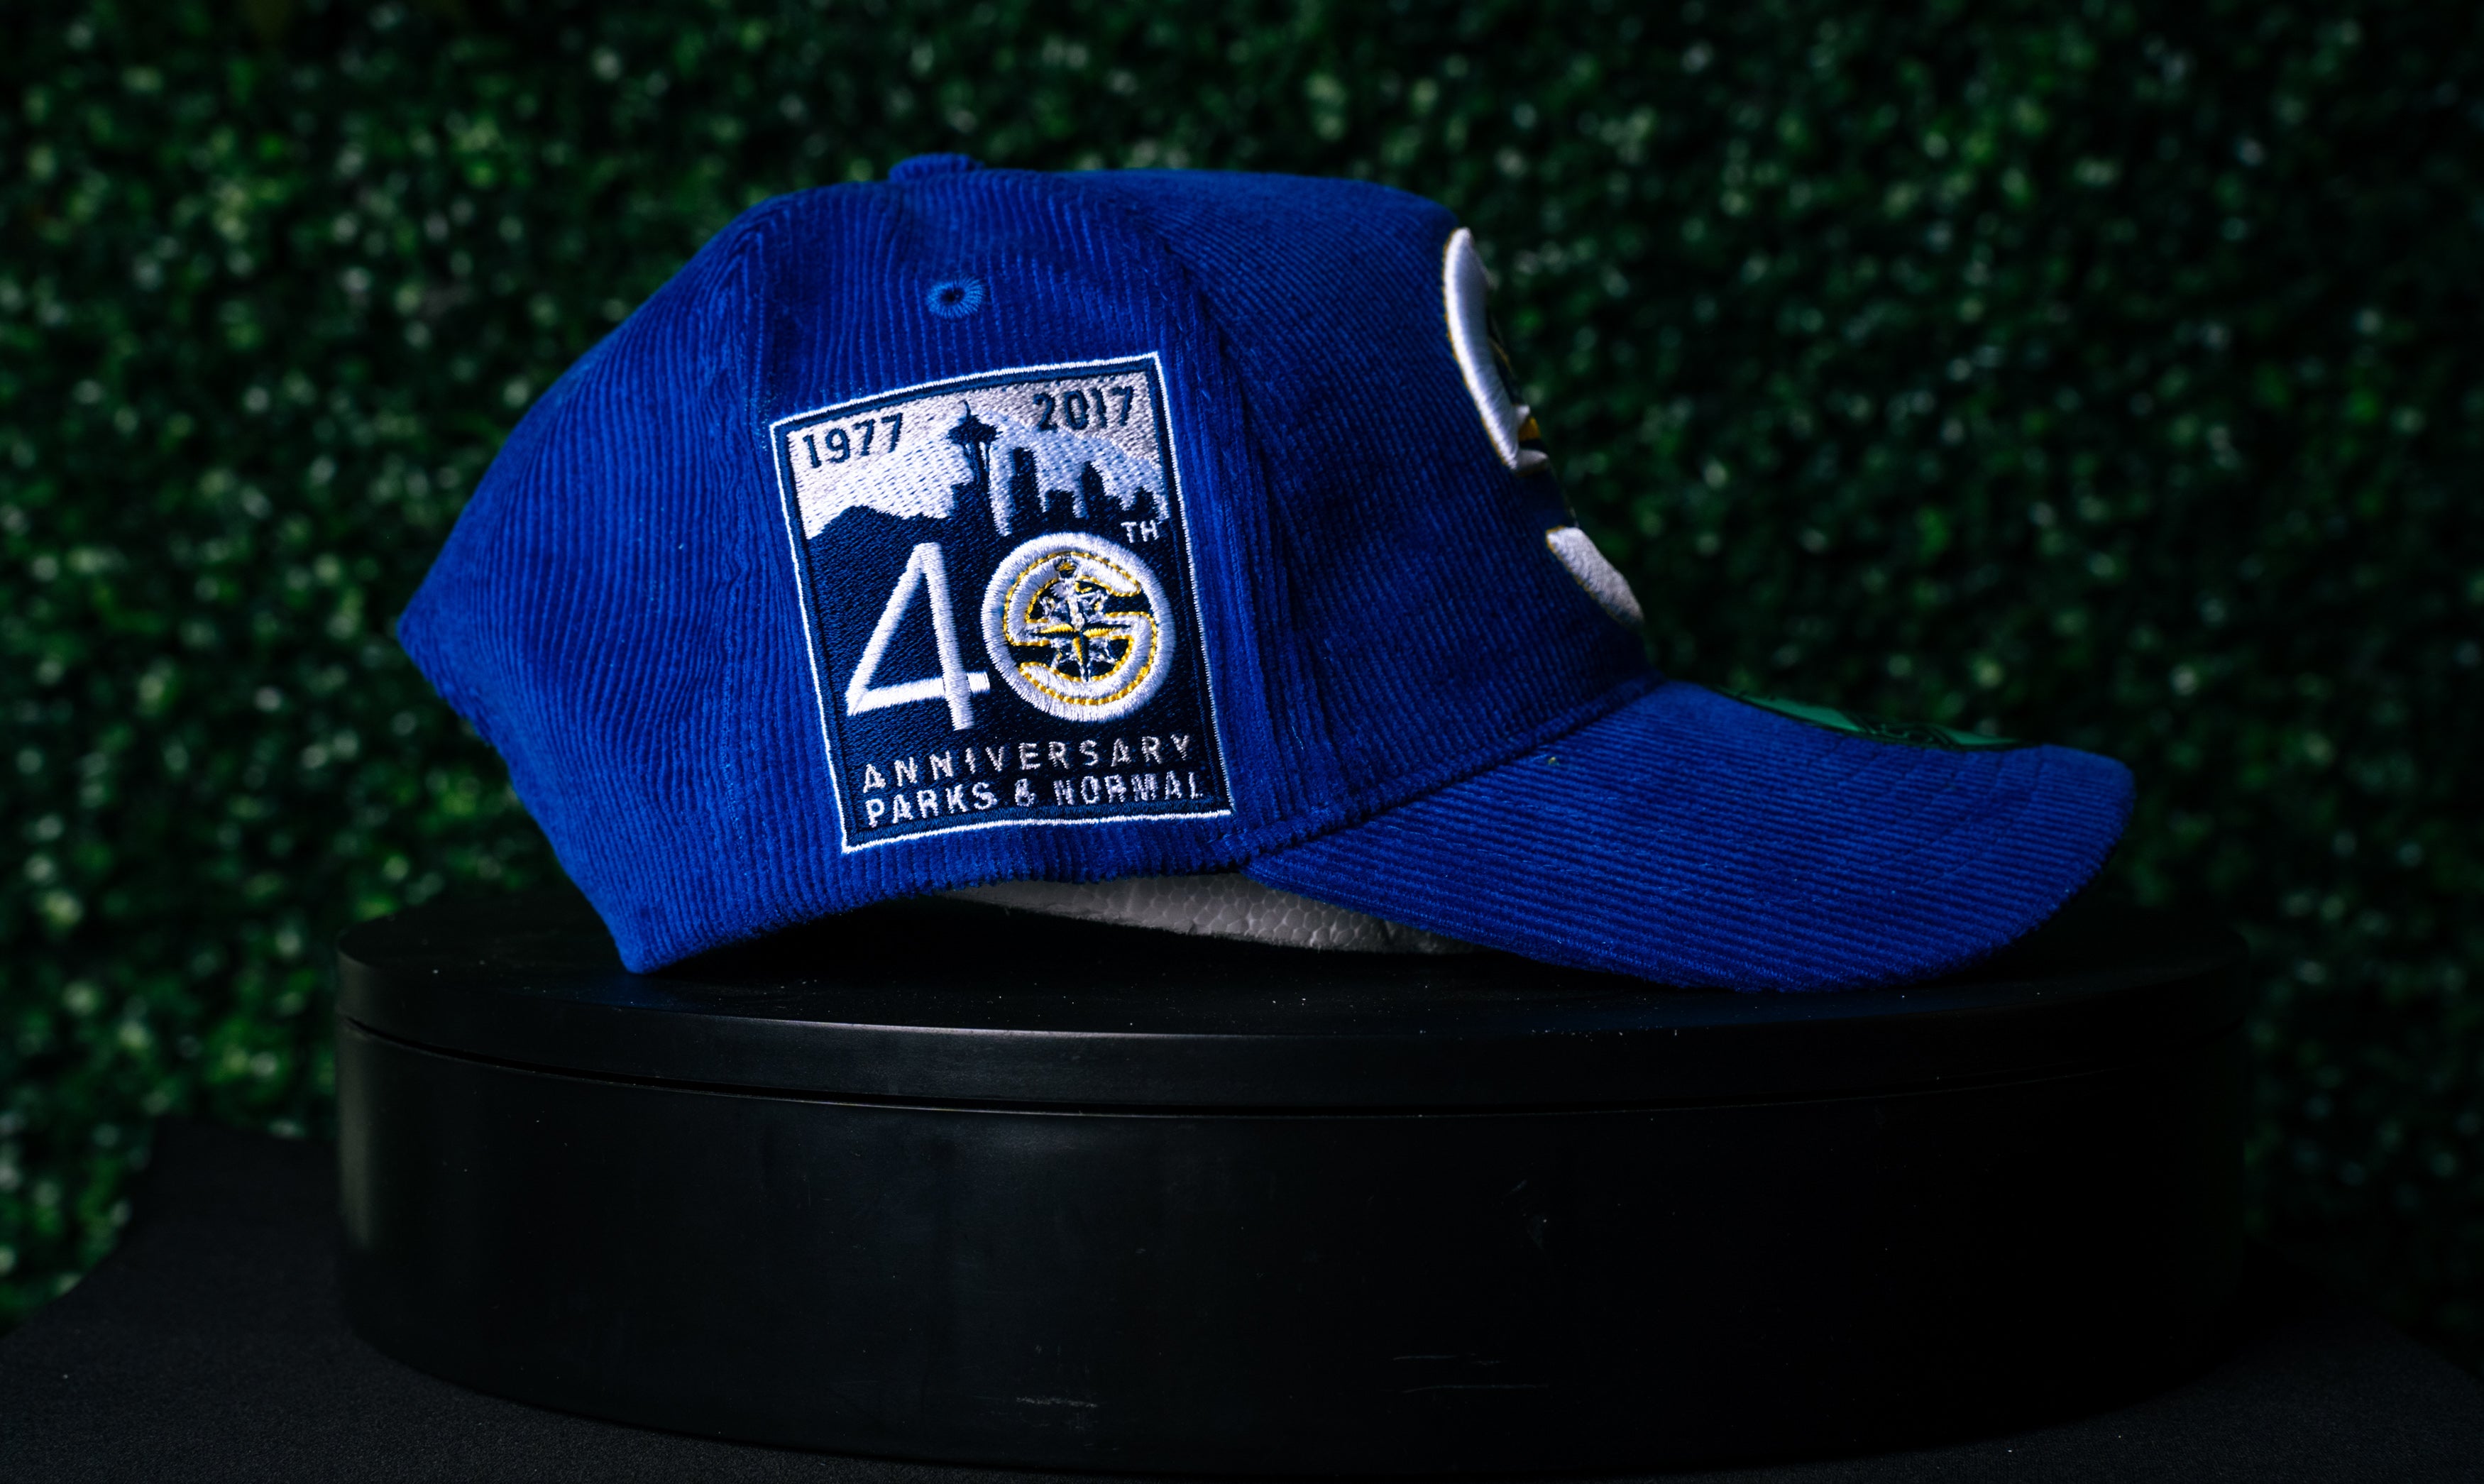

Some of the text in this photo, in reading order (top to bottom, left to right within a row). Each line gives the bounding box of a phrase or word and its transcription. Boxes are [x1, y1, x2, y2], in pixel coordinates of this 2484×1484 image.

[802, 386, 1135, 468] 1977 2017
[1121, 521, 1159, 543] TH
[864, 734, 1190, 793] ANNIVERSARY
[865, 771, 1204, 827] PARKS & NORMAL
